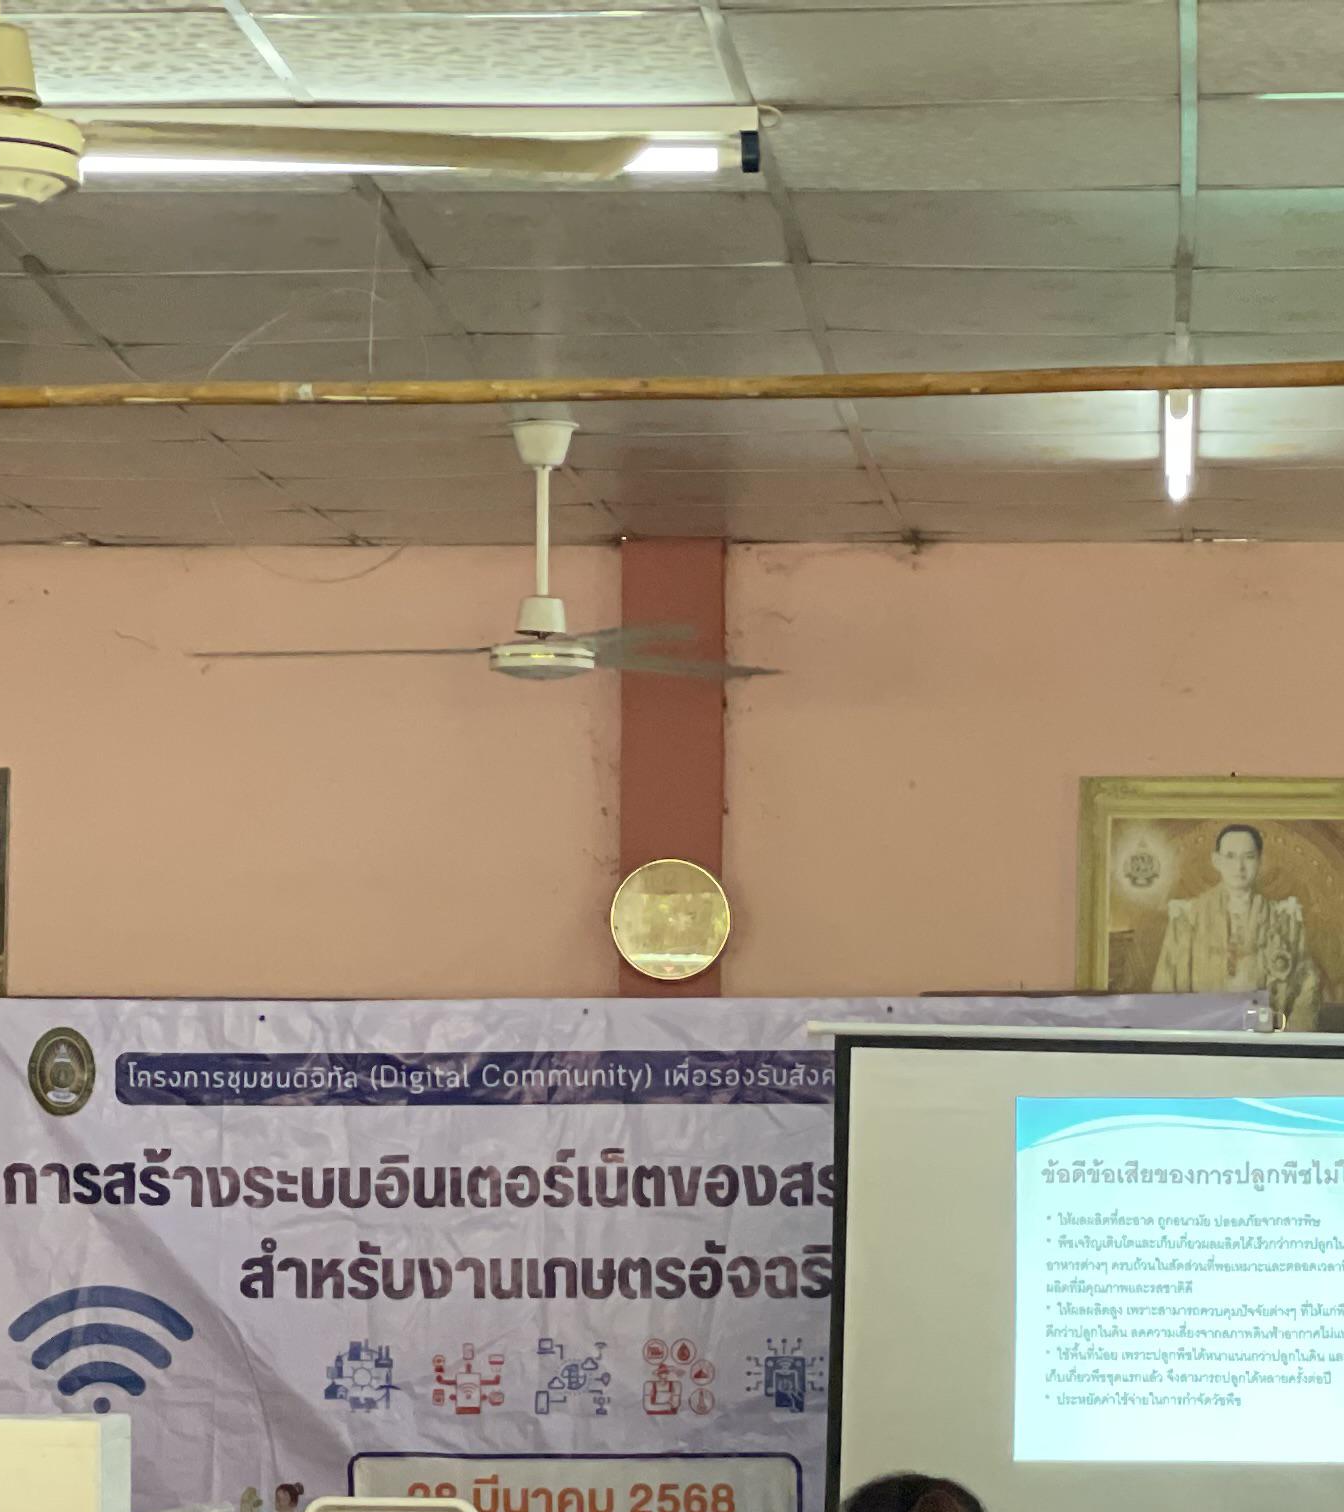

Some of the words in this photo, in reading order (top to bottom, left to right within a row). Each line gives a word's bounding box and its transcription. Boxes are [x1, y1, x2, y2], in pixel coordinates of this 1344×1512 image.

[128, 1061, 356, 1094] โครงการชุมชนดิจิทัล
[370, 1063, 468, 1094] (Digital
[482, 1062, 651, 1092] Community)
[240, 1240, 832, 1300] สำหรับงานเกษตรอัจฉริ
